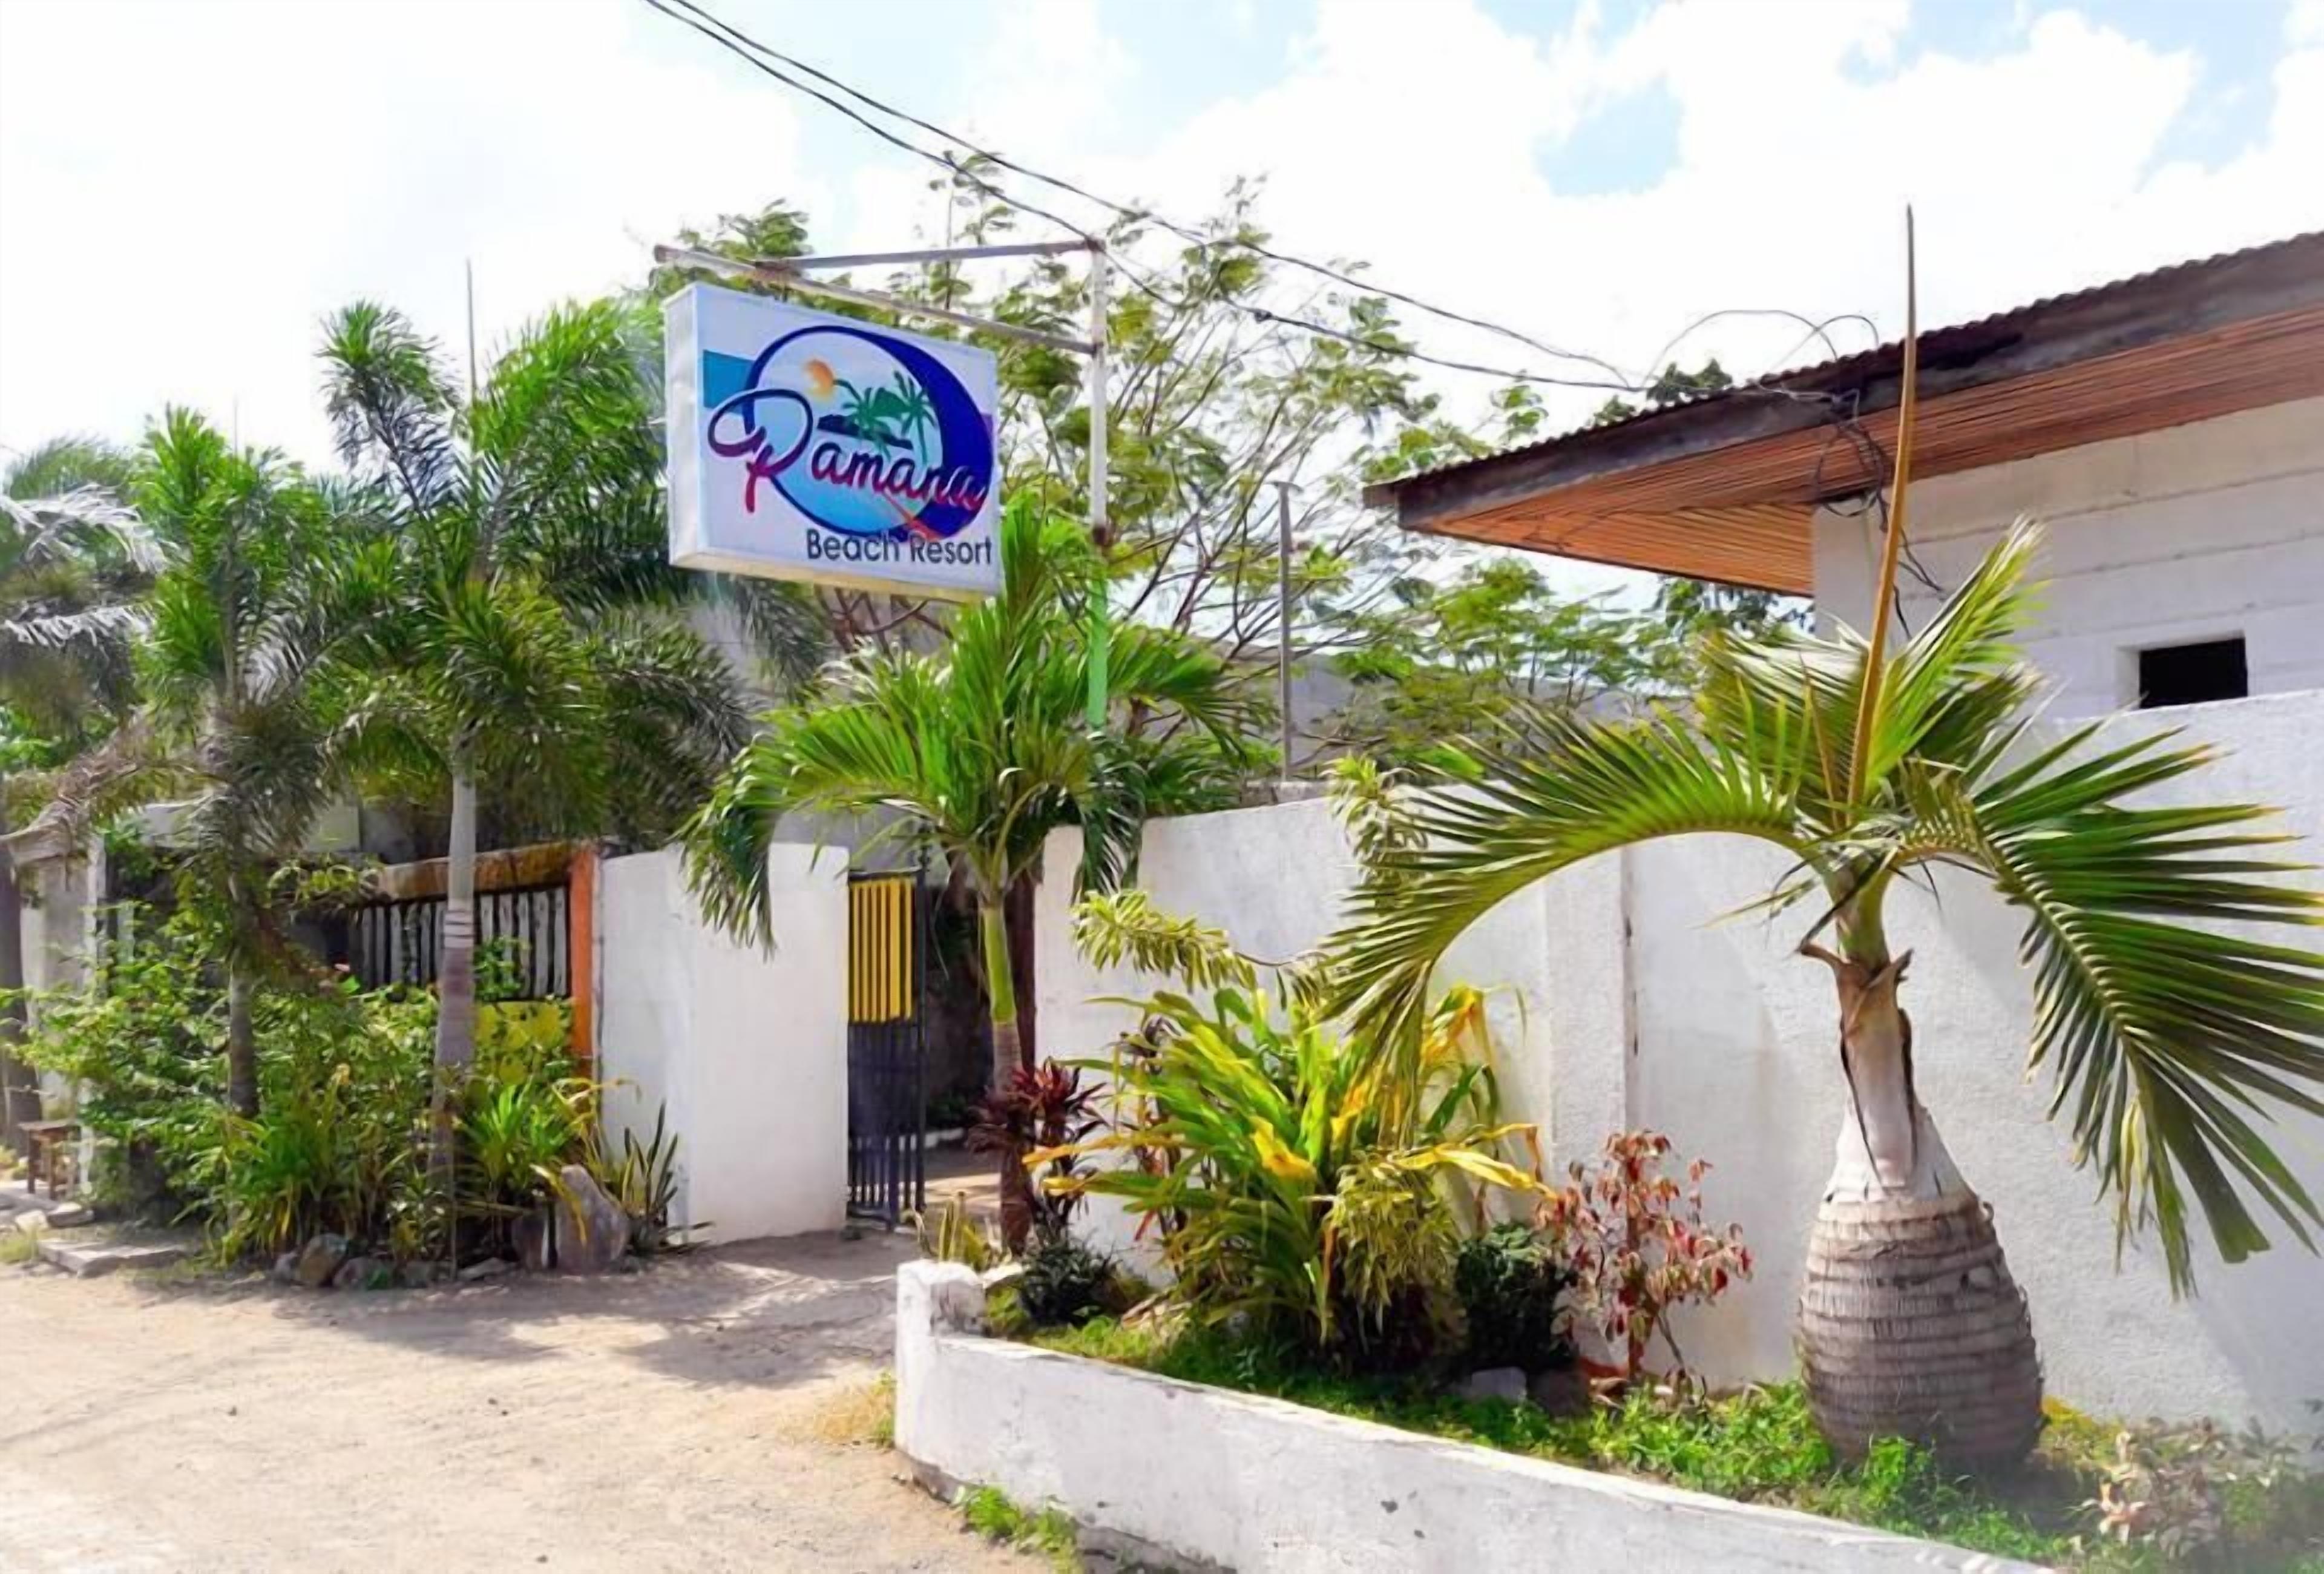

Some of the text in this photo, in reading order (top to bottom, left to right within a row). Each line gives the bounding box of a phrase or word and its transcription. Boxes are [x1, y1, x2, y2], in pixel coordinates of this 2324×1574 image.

[707, 388, 988, 513] Ramana
[807, 529, 992, 565] Beach Resort
